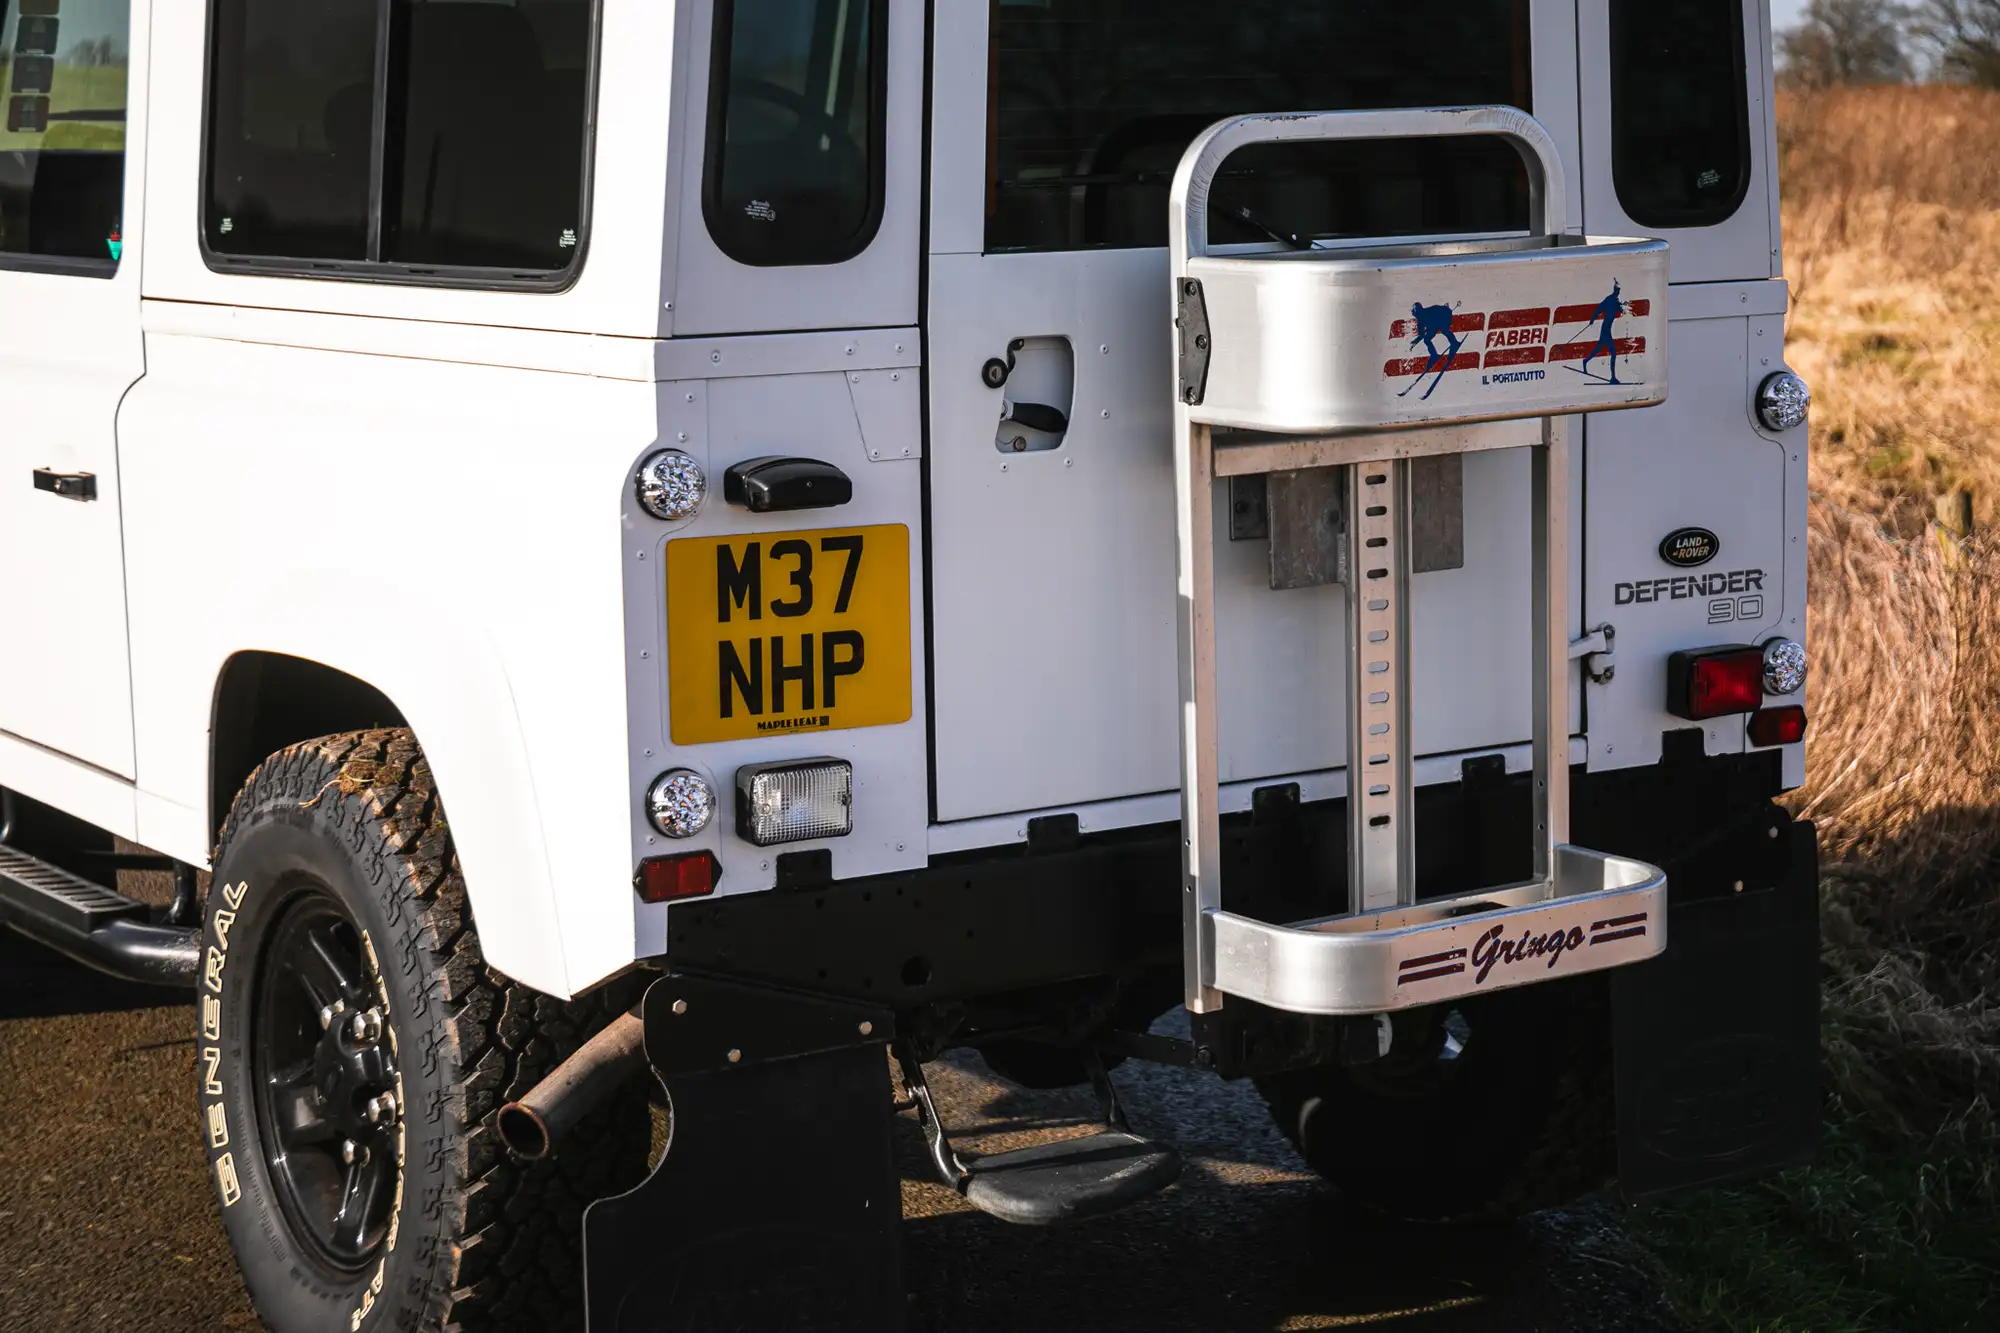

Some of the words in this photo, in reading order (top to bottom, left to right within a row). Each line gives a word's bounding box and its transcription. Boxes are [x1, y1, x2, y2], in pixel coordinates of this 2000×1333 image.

[1485, 327, 1548, 349] FABBRI
[1482, 375, 1490, 385] IL
[1492, 370, 1545, 383] PORTATUTTO
[1676, 537, 1702, 548] LAND
[1678, 546, 1709, 559] ROVER
[717, 535, 864, 623] M37
[1614, 568, 1764, 605] DEFENDER
[1707, 594, 1764, 625] 90
[718, 630, 864, 718] NHP
[757, 718, 792, 730] MAPLE
[794, 716, 818, 727] LEAF
[1471, 925, 1585, 984] Gringo
[201, 880, 249, 1207] GENERAL
